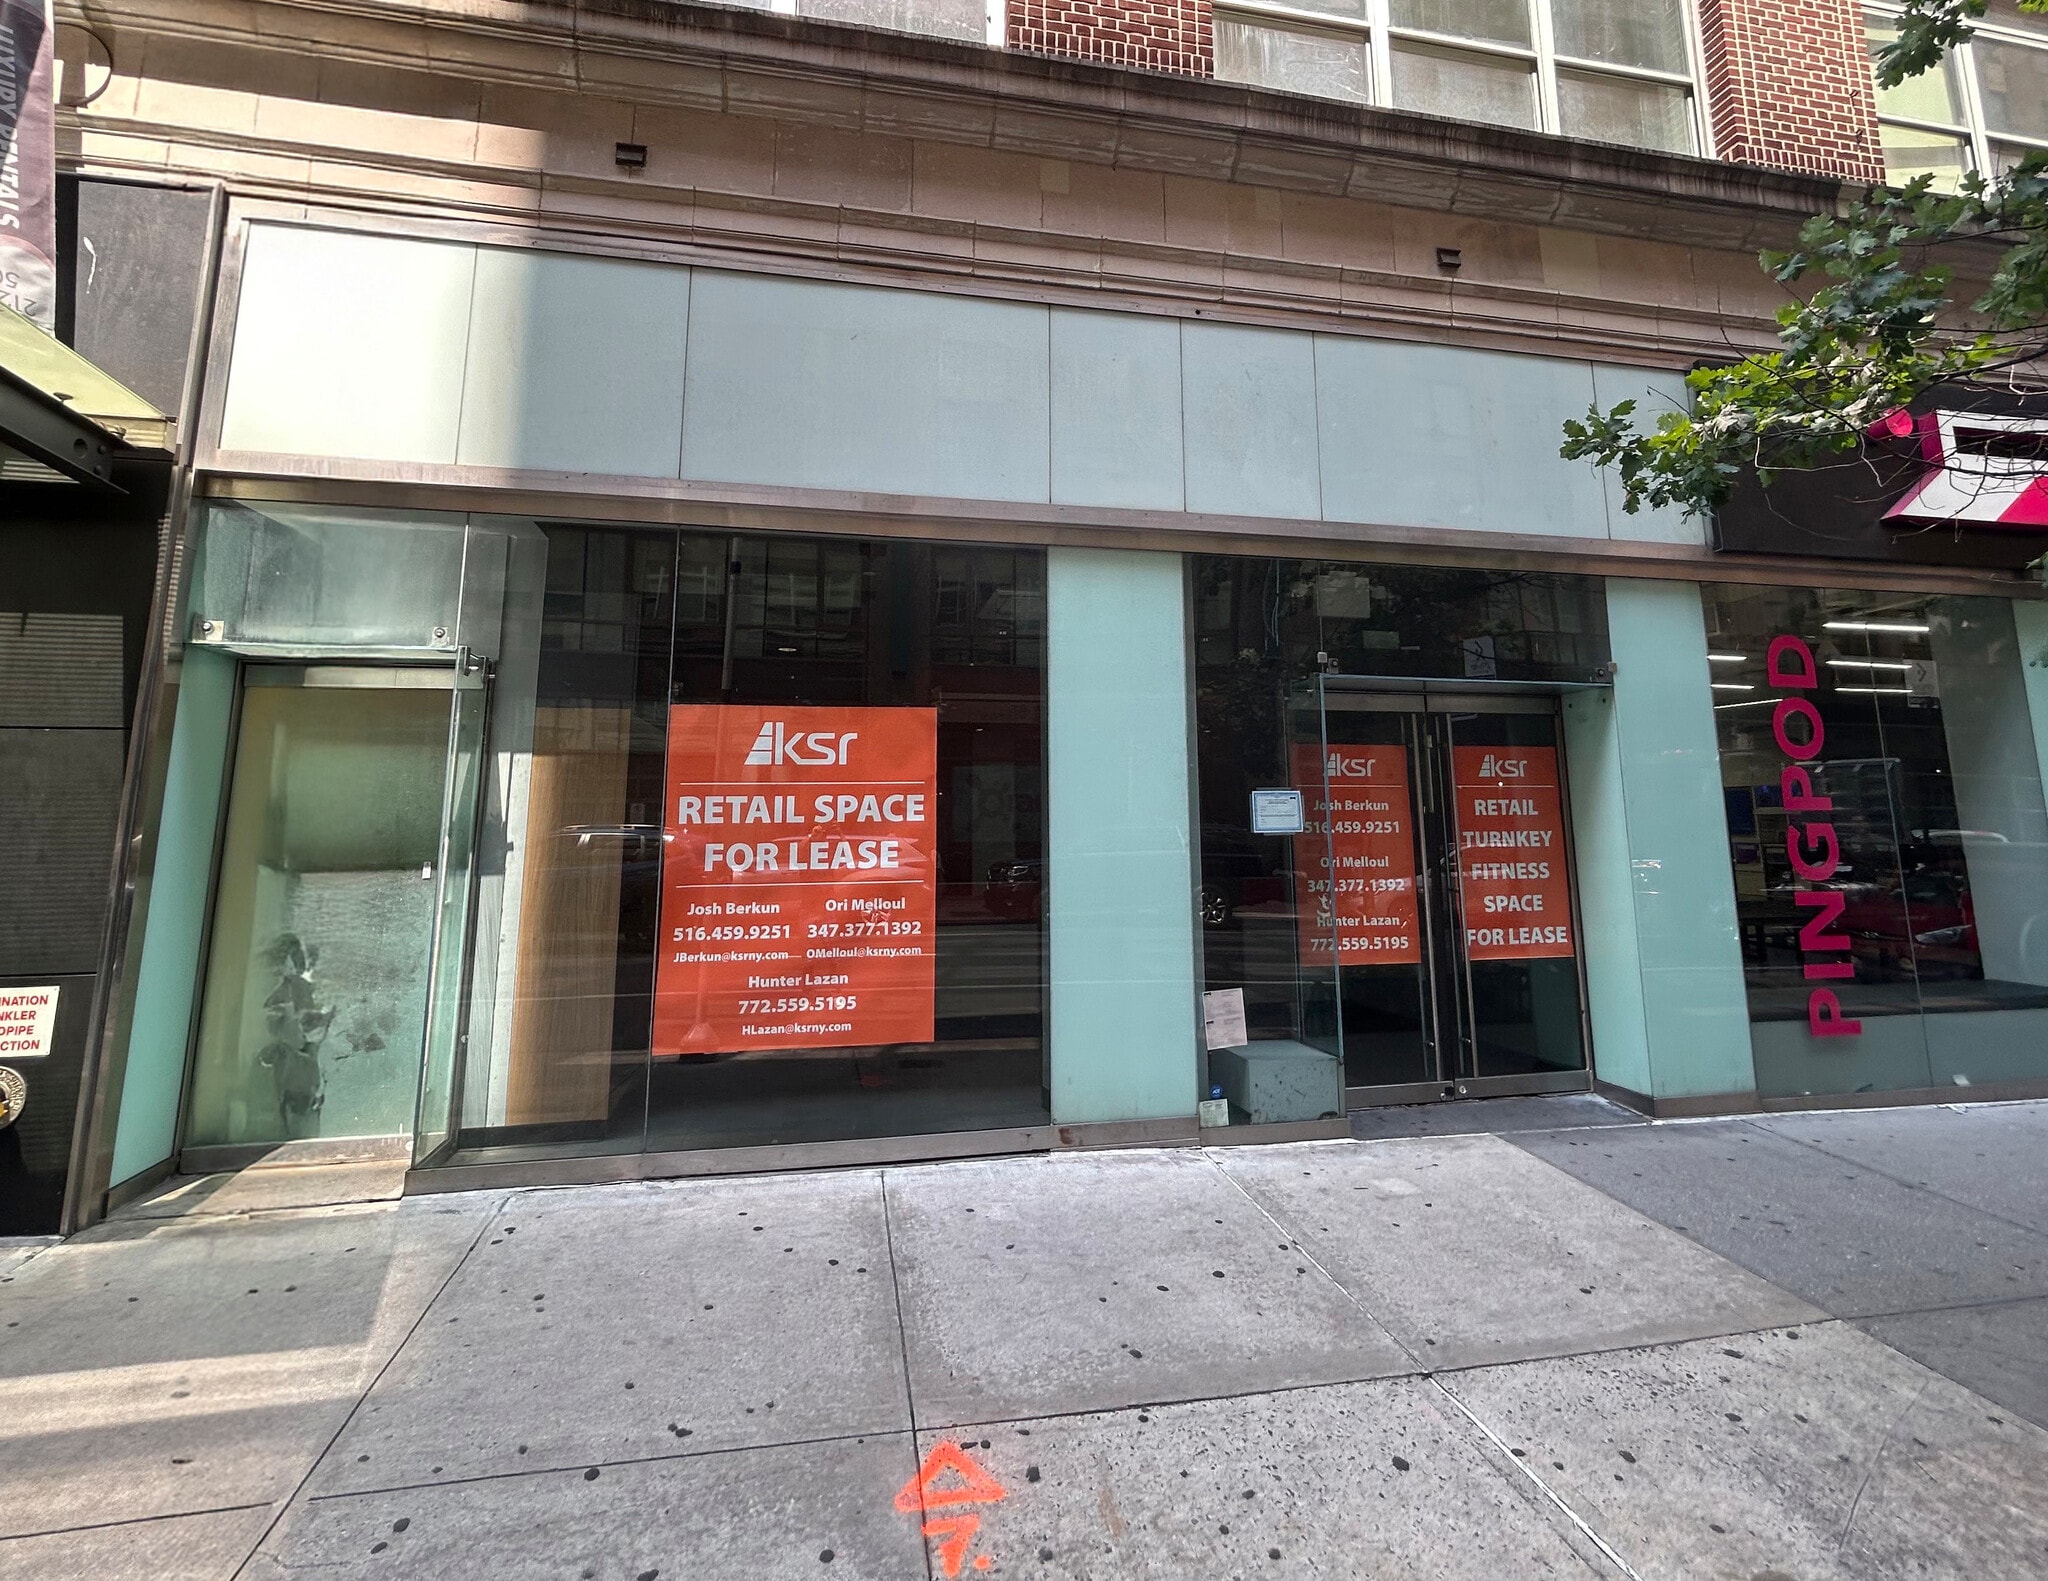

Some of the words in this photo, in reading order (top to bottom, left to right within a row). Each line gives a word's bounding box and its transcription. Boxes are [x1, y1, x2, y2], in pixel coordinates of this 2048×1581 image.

[678, 795, 805, 825] RETAIL
[814, 794, 926, 823] SPACE
[1313, 800, 1342, 811] Josh
[1345, 800, 1389, 811] Berkun
[1474, 799, 1538, 816] RETAIL
[1305, 821, 1400, 834] 516.459.9251
[1463, 831, 1552, 847] TURNKEY
[1767, 634, 1863, 1038] PINGPOD
[703, 842, 779, 872] FOR
[789, 840, 900, 870] LEASE
[1343, 856, 1389, 868] Melloul
[1471, 862, 1550, 880] FITNESS
[1308, 879, 1405, 892] 347.377.1392
[687, 902, 722, 917] Josh
[725, 902, 781, 915] Berkun
[825, 899, 849, 912] Ori
[852, 897, 906, 912] Melloul
[1483, 894, 1544, 913] SPACE
[1363, 915, 1400, 926] Lazan
[673, 925, 791, 942] 516.459.9251
[807, 921, 922, 939] 347.377.1392
[1466, 928, 1504, 946] FOR
[1508, 926, 1569, 945] LEASE
[1311, 936, 1409, 951] 772.559.5195
[673, 950, 789, 963] JBerkun@ksrny.com
[806, 946, 922, 959] OMelloul@ksrny.com
[748, 974, 802, 989] Hunter
[805, 973, 849, 986] Lazan
[738, 996, 857, 1014] 772.559.5195
[741, 1022, 852, 1036] HLazan@ksrny.com
